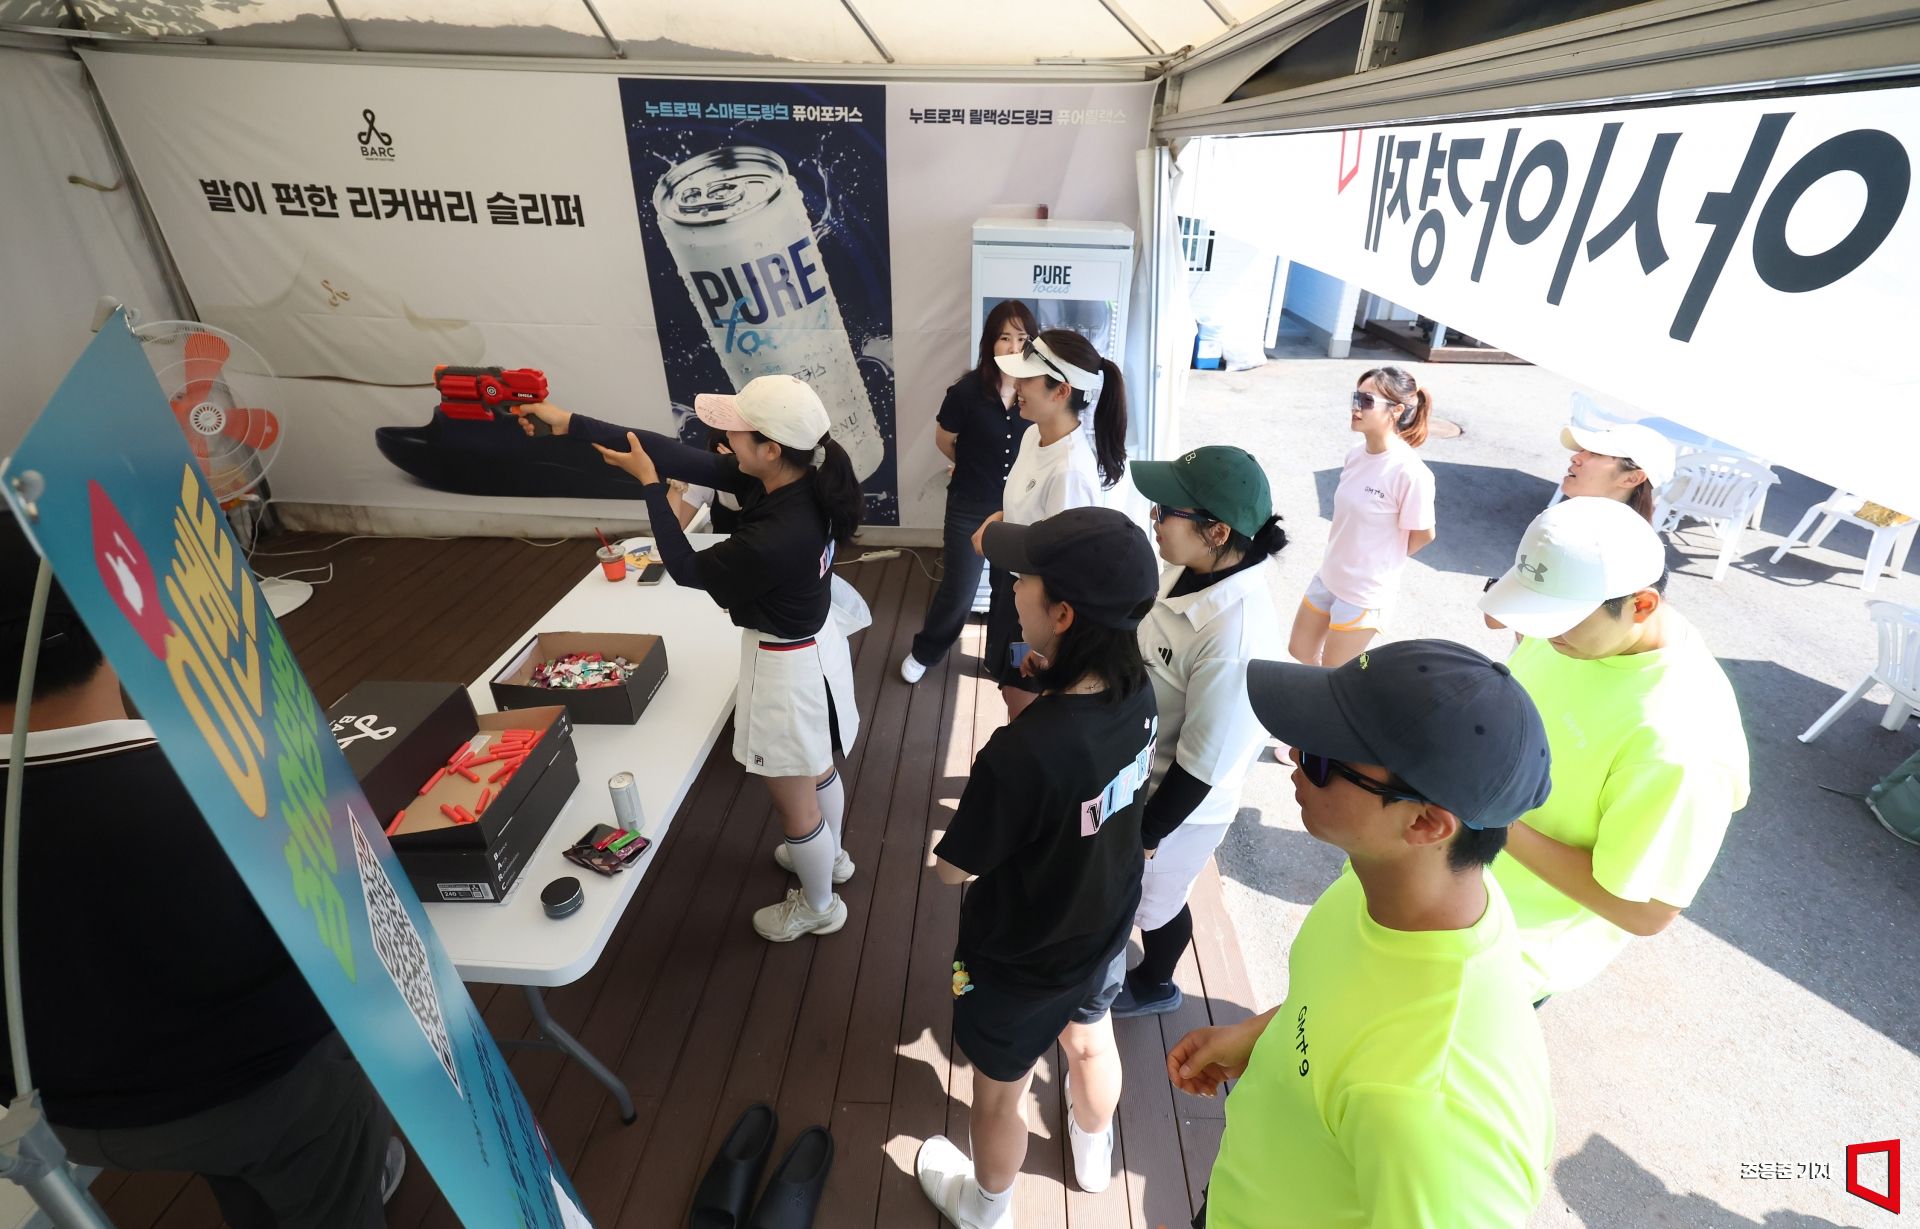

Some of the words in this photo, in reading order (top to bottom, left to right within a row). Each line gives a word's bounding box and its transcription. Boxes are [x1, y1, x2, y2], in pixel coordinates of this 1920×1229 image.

[645, 101, 701, 118] 누트로픽
[705, 102, 789, 121] 스마트드링크
[792, 105, 863, 122] 퓨어포커스
[909, 108, 965, 124] 누트로픽
[969, 109, 1053, 125] 릴랙싱드링크
[360, 146, 396, 158] BARC
[198, 179, 267, 215] 발이
[271, 183, 340, 218] 편한
[346, 187, 478, 224] 리커버리
[486, 191, 585, 227] 슬리퍼
[689, 235, 827, 328] PURE
[1033, 264, 1072, 285] PURE
[1032, 277, 1072, 294] focus
[163, 463, 267, 819] 이벤트
[1296, 1005, 1310, 1077] GMT+9
